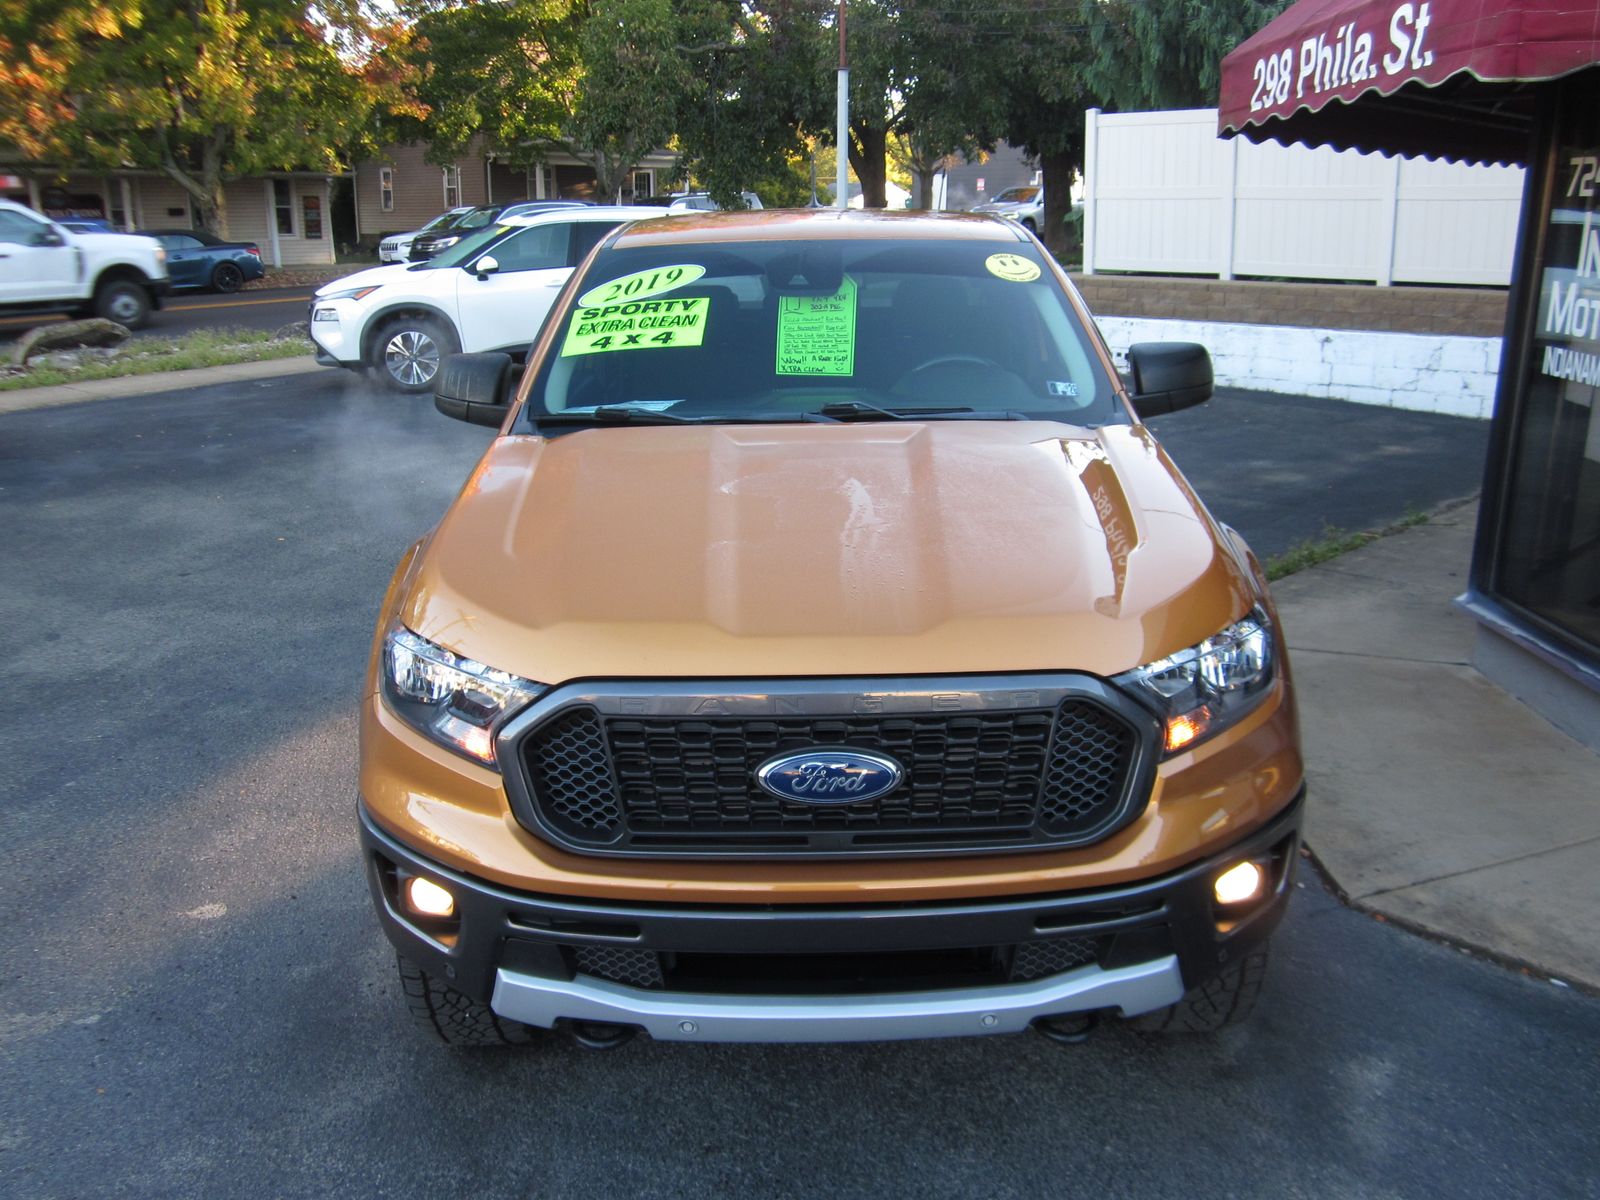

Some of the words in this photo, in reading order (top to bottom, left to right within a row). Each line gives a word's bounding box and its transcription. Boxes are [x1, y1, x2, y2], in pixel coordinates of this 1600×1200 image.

[1250, 48, 1293, 112] 298
[1296, 22, 1378, 98] Phila.
[1383, 3, 1433, 75] St.
[1566, 156, 1600, 197] 72
[604, 268, 684, 302] 2019
[576, 317, 635, 337] EXTRA
[638, 313, 700, 330] CLEAN
[581, 299, 702, 320] SPORTY
[618, 689, 1041, 716] RANGER
[791, 761, 869, 793] Ford
